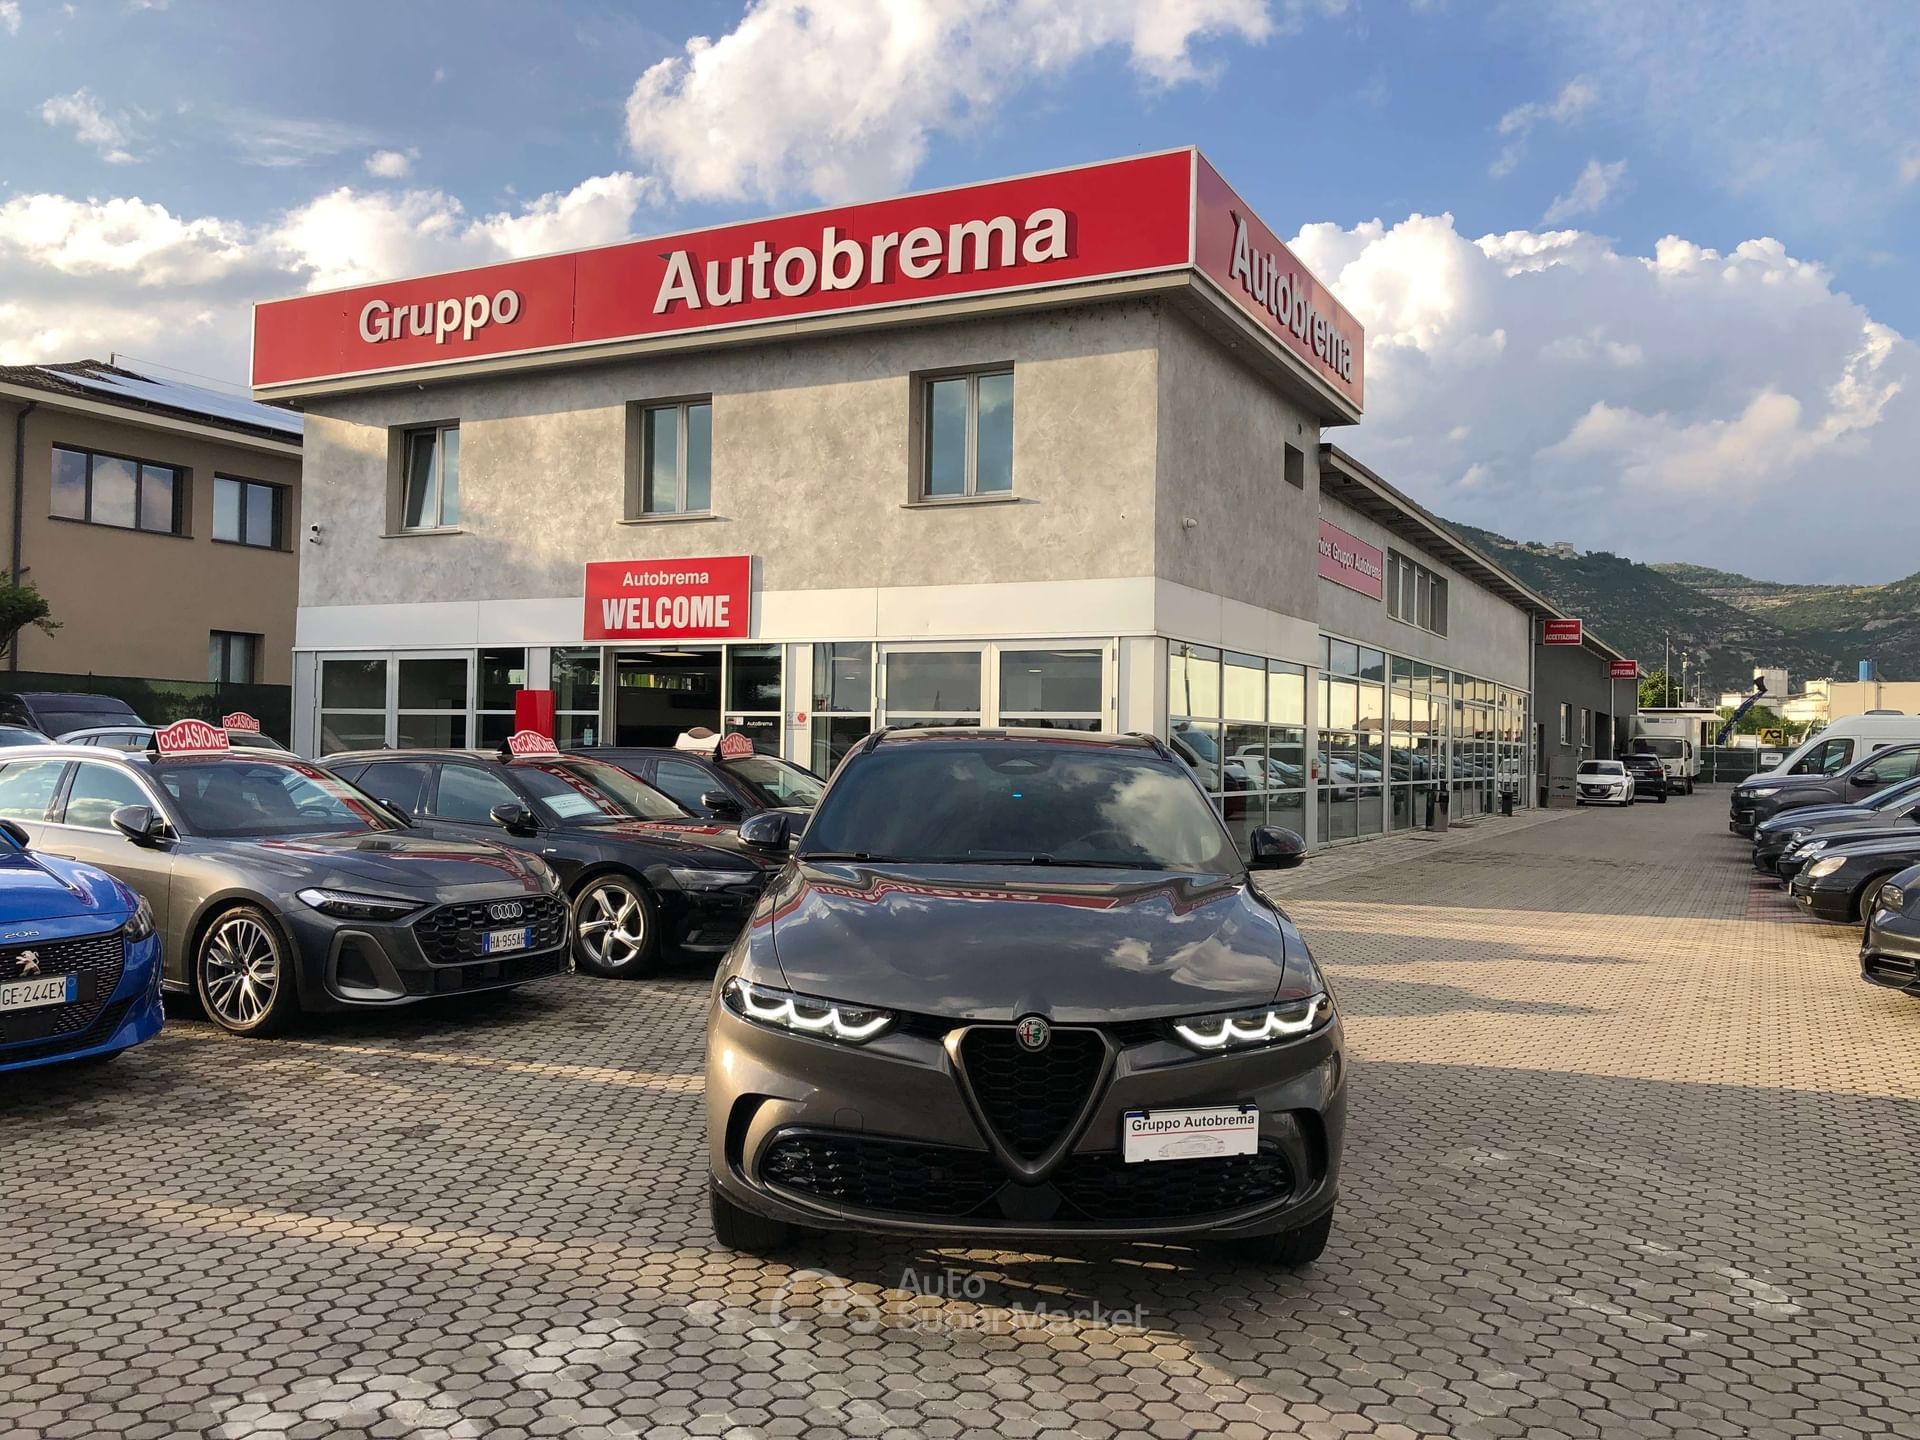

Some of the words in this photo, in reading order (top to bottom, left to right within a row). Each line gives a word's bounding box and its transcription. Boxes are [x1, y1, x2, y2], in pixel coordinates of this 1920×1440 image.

[359, 289, 520, 344] Gruppo
[652, 207, 1068, 314] Autobrema
[1231, 217, 1353, 384] Autobrema
[1332, 542, 1354, 569] Gruppo
[1354, 553, 1382, 580] Autobrema
[622, 571, 709, 587] Autobrema
[602, 595, 730, 630] WELCOME
[1545, 633, 1580, 641] ACCETTAZIONE
[224, 714, 259, 730] OCCASIONE
[160, 723, 227, 749] OCCASIONE
[512, 733, 557, 752] OCCASIONE
[722, 735, 753, 754] OCCASIONE
[1131, 1119, 1181, 1132] Gruppo
[1184, 1113, 1255, 1128] Autobrema
